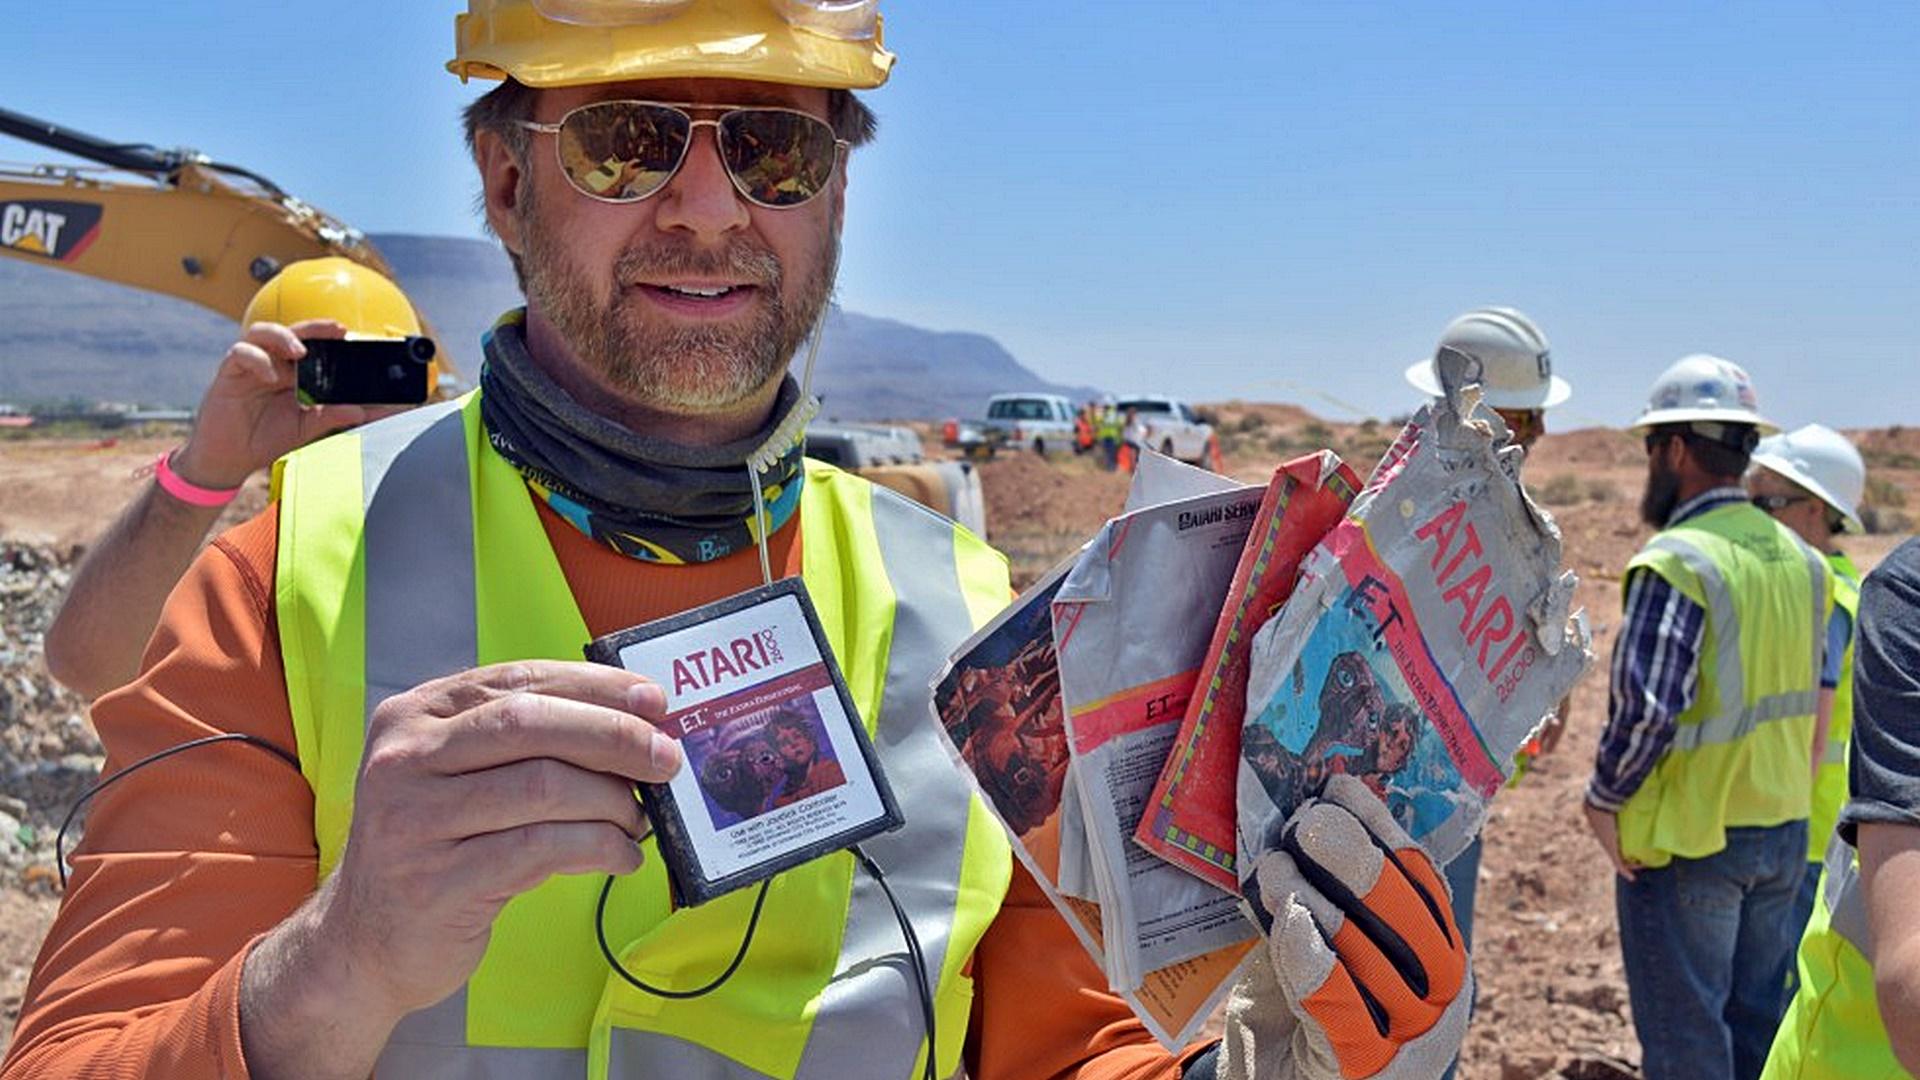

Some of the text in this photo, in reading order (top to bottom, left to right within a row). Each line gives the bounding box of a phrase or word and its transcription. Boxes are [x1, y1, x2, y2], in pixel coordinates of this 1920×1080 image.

[2, 203, 67, 255] CAT
[1415, 501, 1527, 683] ATARI
[672, 633, 771, 696] ATARI
